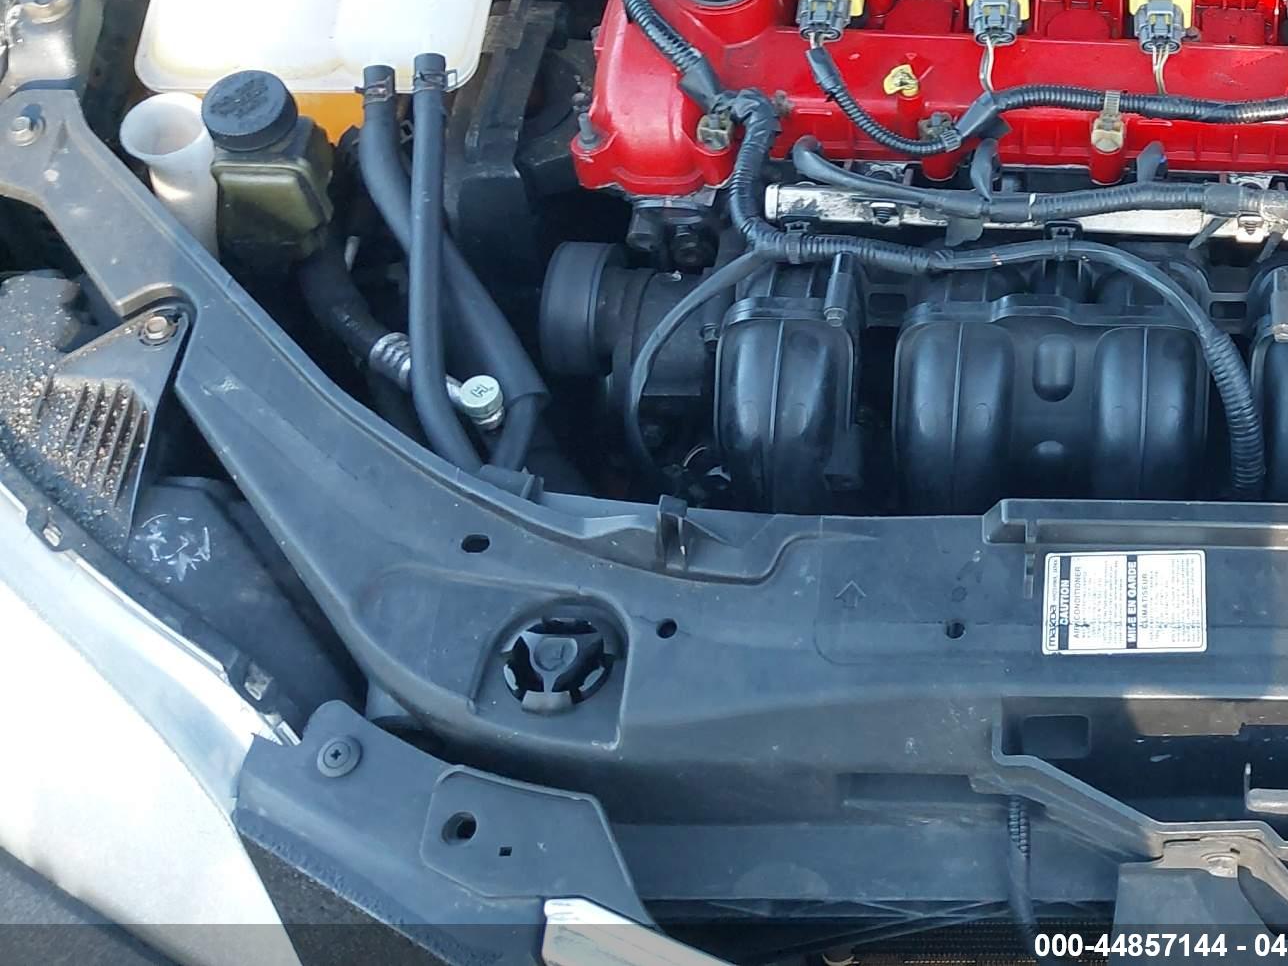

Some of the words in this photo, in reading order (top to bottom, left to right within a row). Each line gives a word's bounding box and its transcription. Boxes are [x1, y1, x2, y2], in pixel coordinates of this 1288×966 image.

[1128, 561, 1137, 598] GARDE
[1060, 580, 1069, 625] CAUTION
[1128, 600, 1136, 614] EN
[1048, 604, 1057, 647] mazda
